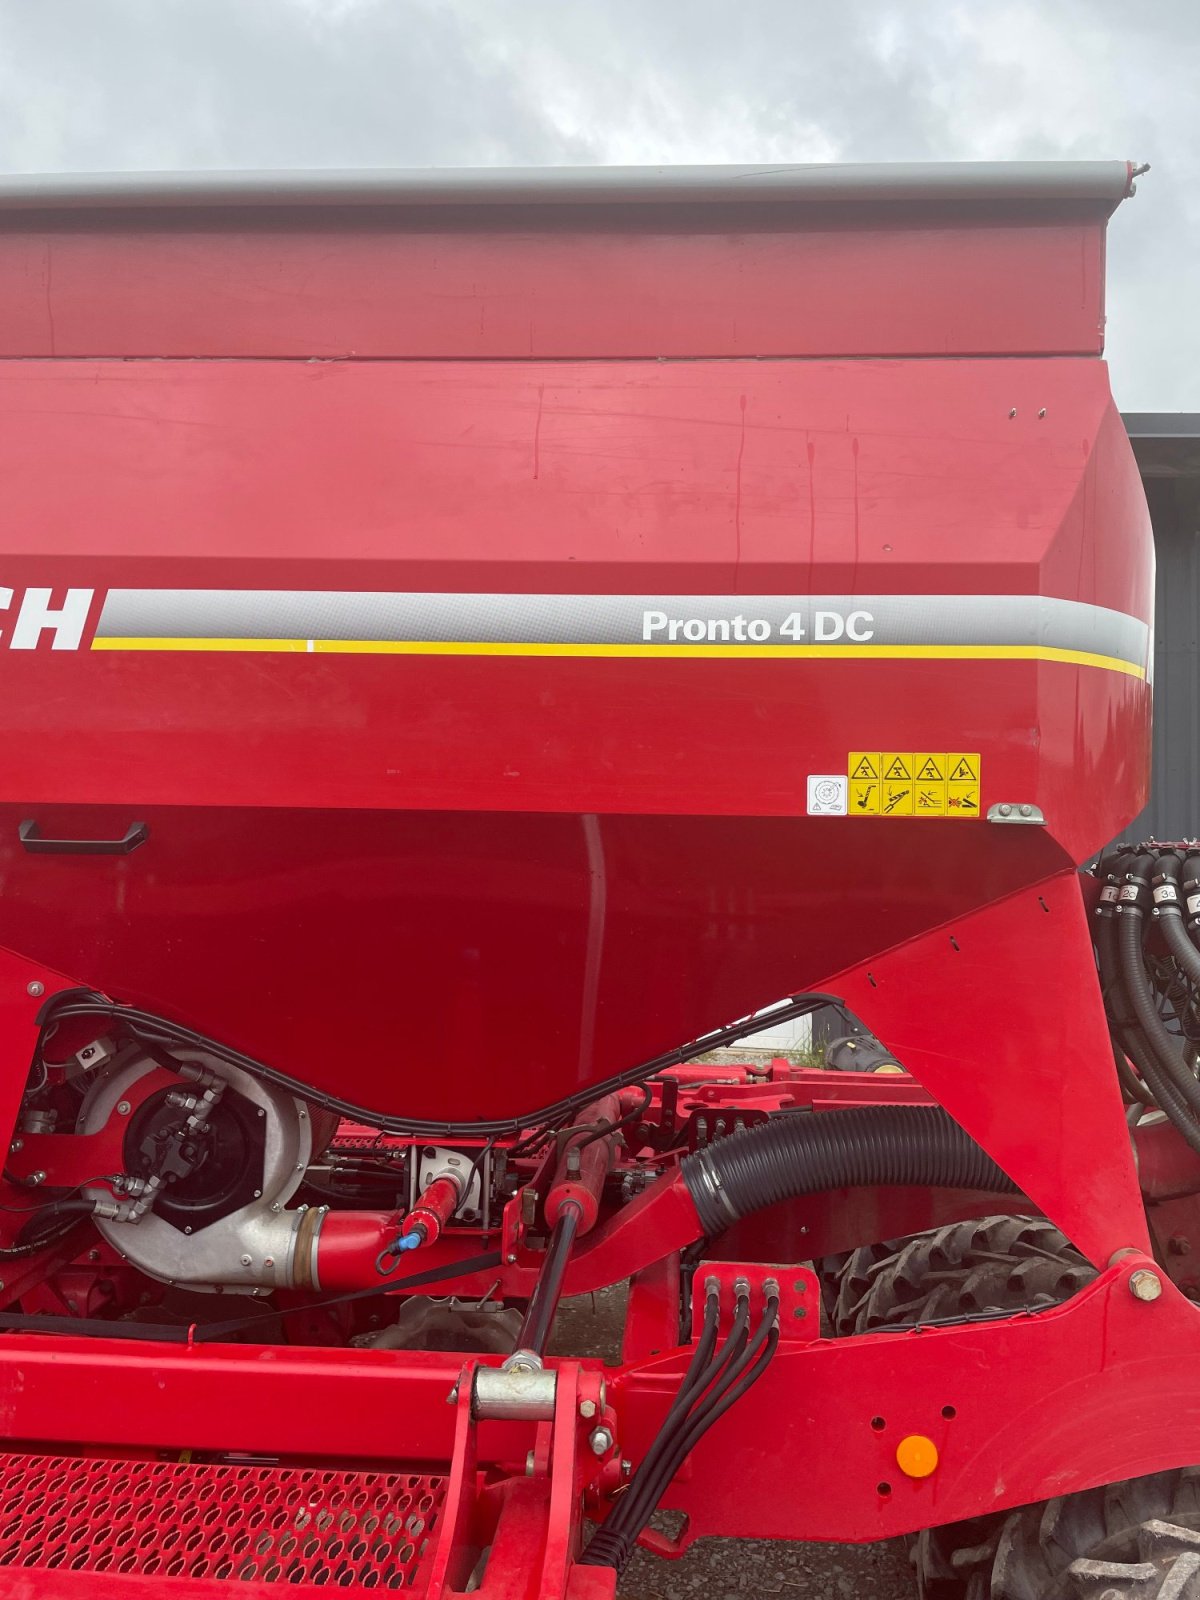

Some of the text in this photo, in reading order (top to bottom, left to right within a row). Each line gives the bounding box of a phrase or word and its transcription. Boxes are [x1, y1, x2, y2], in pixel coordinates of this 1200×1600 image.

[0, 587, 95, 650] H
[643, 610, 875, 642] Pronto 4 DC
